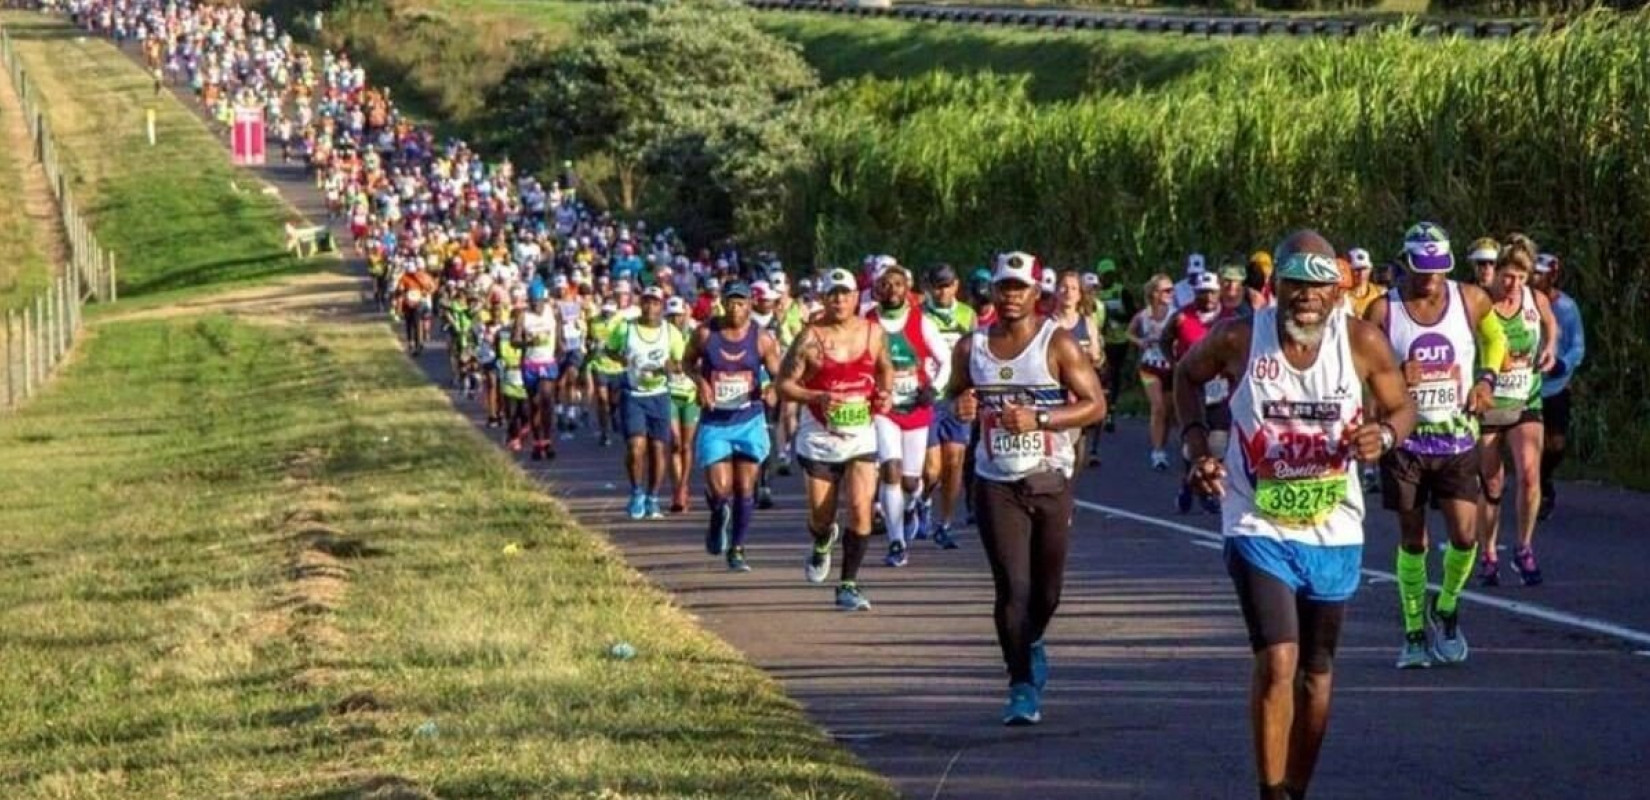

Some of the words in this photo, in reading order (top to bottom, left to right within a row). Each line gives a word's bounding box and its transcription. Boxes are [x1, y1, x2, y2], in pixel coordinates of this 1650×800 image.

[1415, 345, 1450, 361] OUT
[1255, 357, 1280, 380] 60
[994, 432, 1042, 452] 40465
[1270, 484, 1336, 510] 39275
